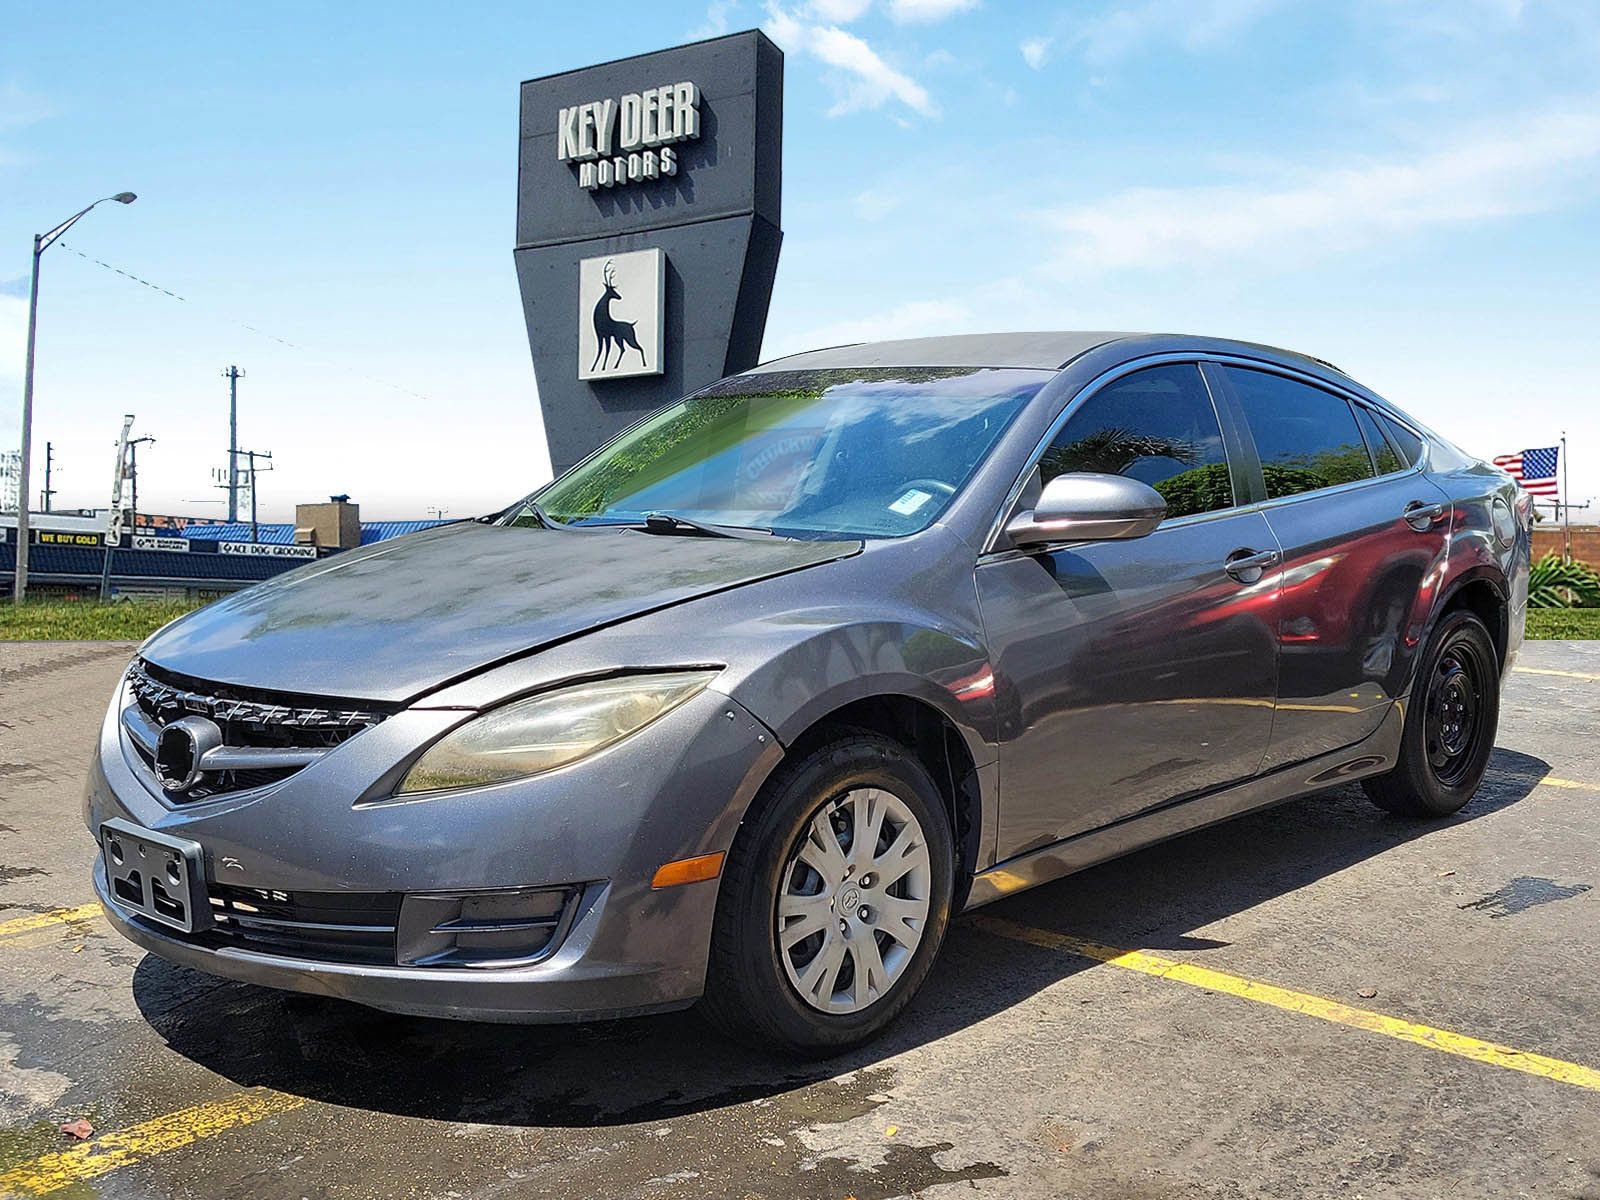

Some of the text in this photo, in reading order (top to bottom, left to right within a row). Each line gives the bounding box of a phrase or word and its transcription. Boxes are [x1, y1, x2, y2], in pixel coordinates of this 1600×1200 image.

[558, 81, 700, 160] KEY DEER
[579, 146, 677, 190] MOTORS
[41, 533, 98, 545] WE BUY GOLD
[232, 545, 316, 557] ACE DOG GROOMING
